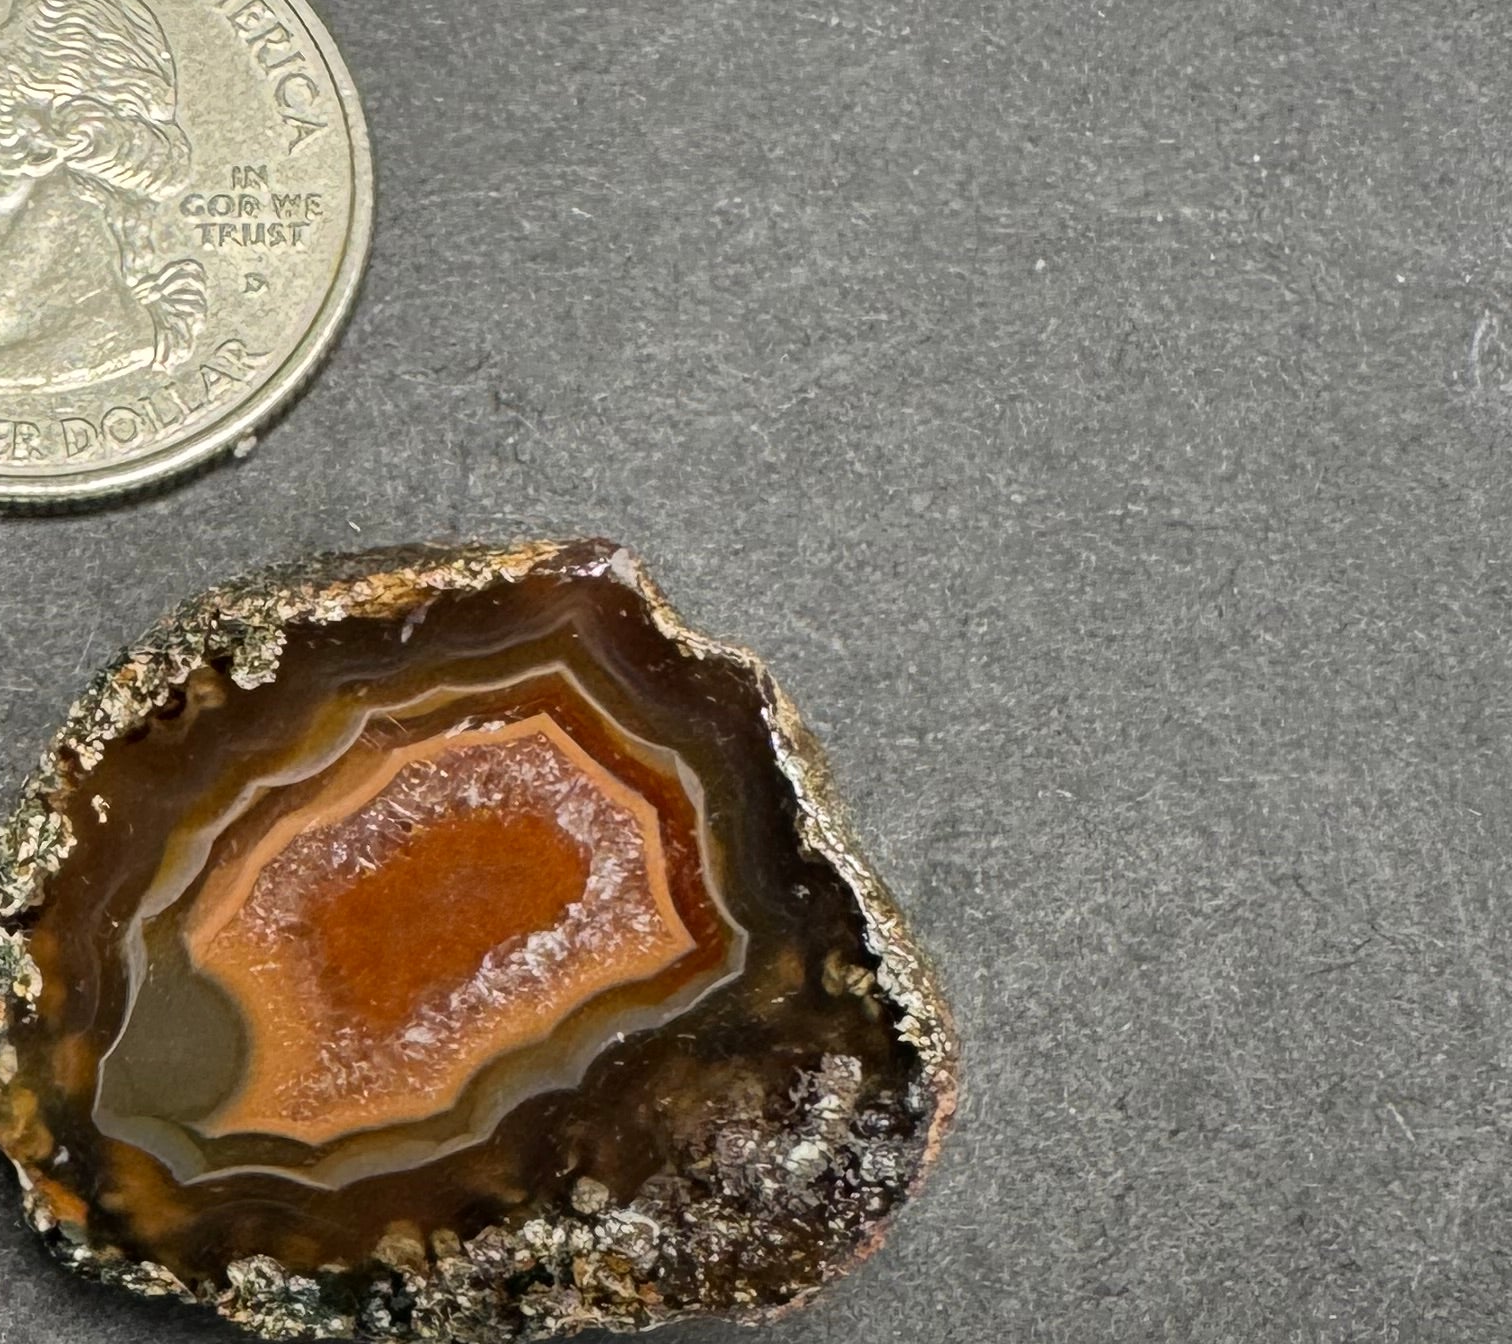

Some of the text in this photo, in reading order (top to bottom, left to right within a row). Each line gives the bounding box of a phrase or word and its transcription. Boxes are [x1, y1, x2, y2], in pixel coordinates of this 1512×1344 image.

[232, 166, 269, 188] IN
[271, 193, 322, 217] WE
[196, 222, 310, 246] TRUST
[63, 339, 267, 457] DOLLAR
